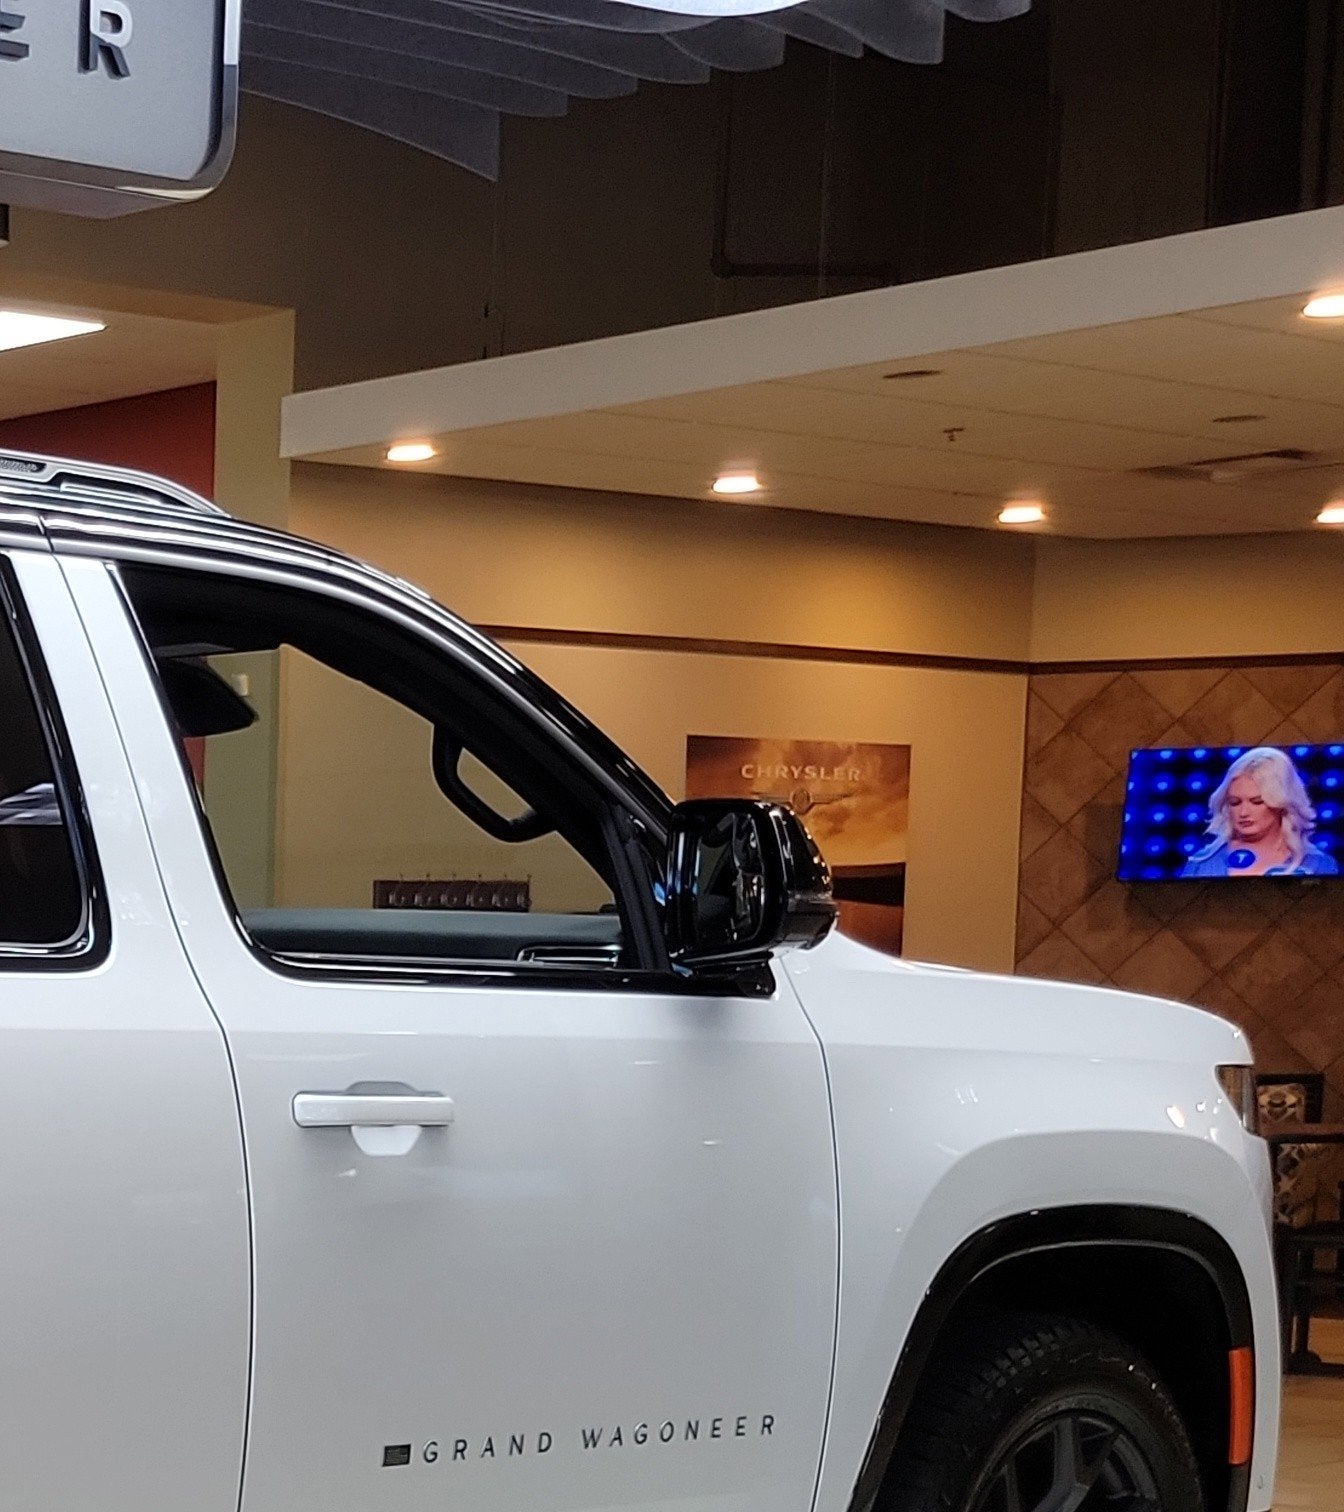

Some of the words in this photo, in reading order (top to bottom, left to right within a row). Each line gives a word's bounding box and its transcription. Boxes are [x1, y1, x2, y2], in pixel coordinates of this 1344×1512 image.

[741, 764, 861, 782] CHRYSLER
[422, 1431, 553, 1464] GRAND
[581, 1414, 775, 1450] WAGONEER
